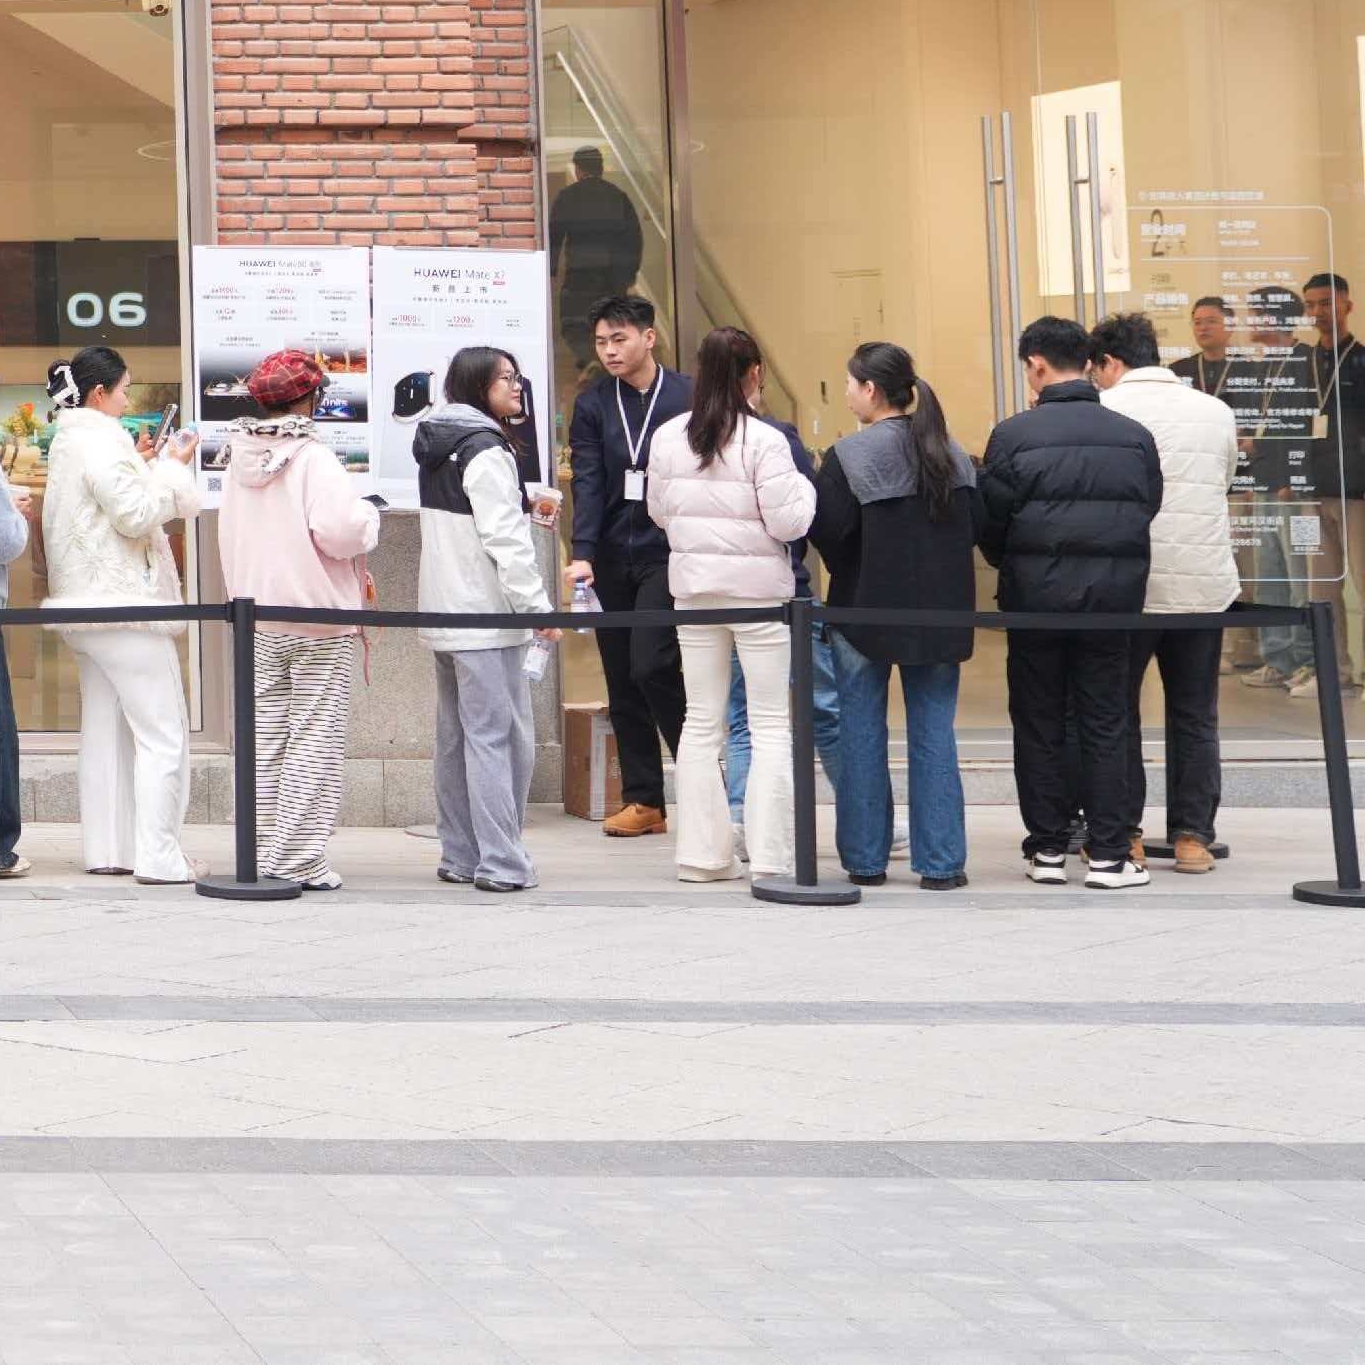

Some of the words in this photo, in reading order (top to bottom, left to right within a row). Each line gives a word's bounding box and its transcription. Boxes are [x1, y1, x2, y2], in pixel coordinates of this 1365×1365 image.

[239, 260, 276, 268] HUAWEI
[413, 269, 461, 279] HUAWEI
[66, 291, 148, 328] 06
